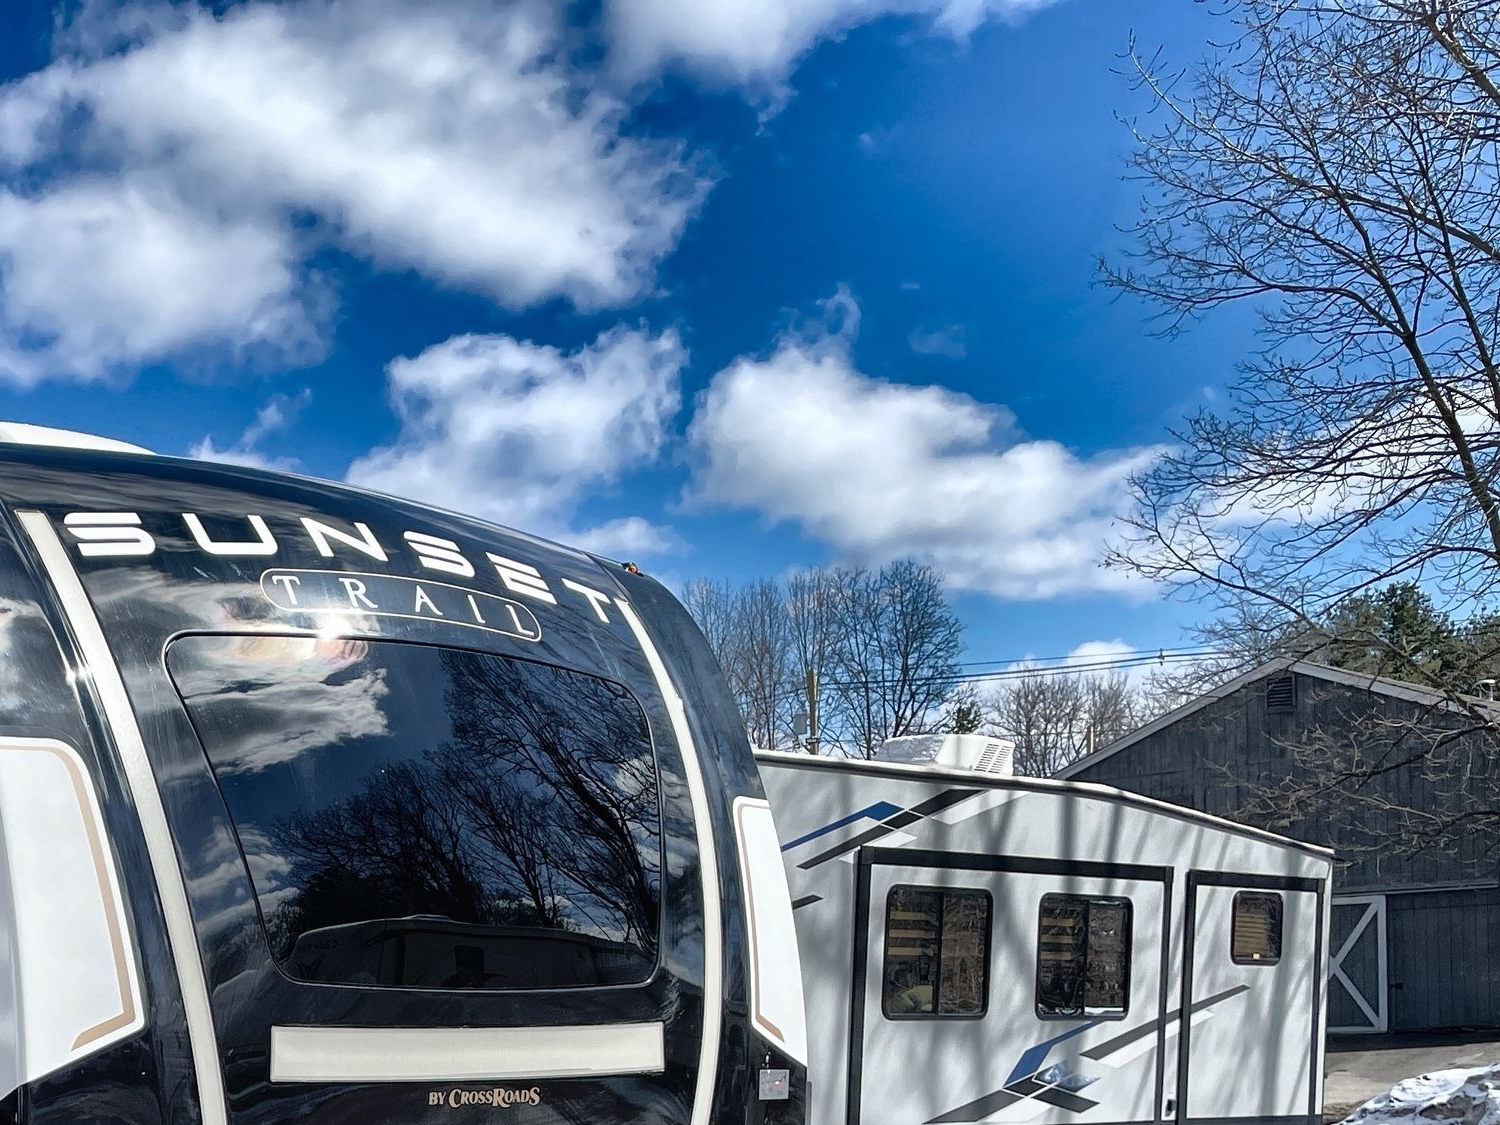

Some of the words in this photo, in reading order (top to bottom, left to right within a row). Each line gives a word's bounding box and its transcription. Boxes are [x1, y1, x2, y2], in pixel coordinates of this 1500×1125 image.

[63, 512, 616, 623] SUNSET
[272, 575, 536, 638] TRAIL
[428, 1091, 447, 1106] BY
